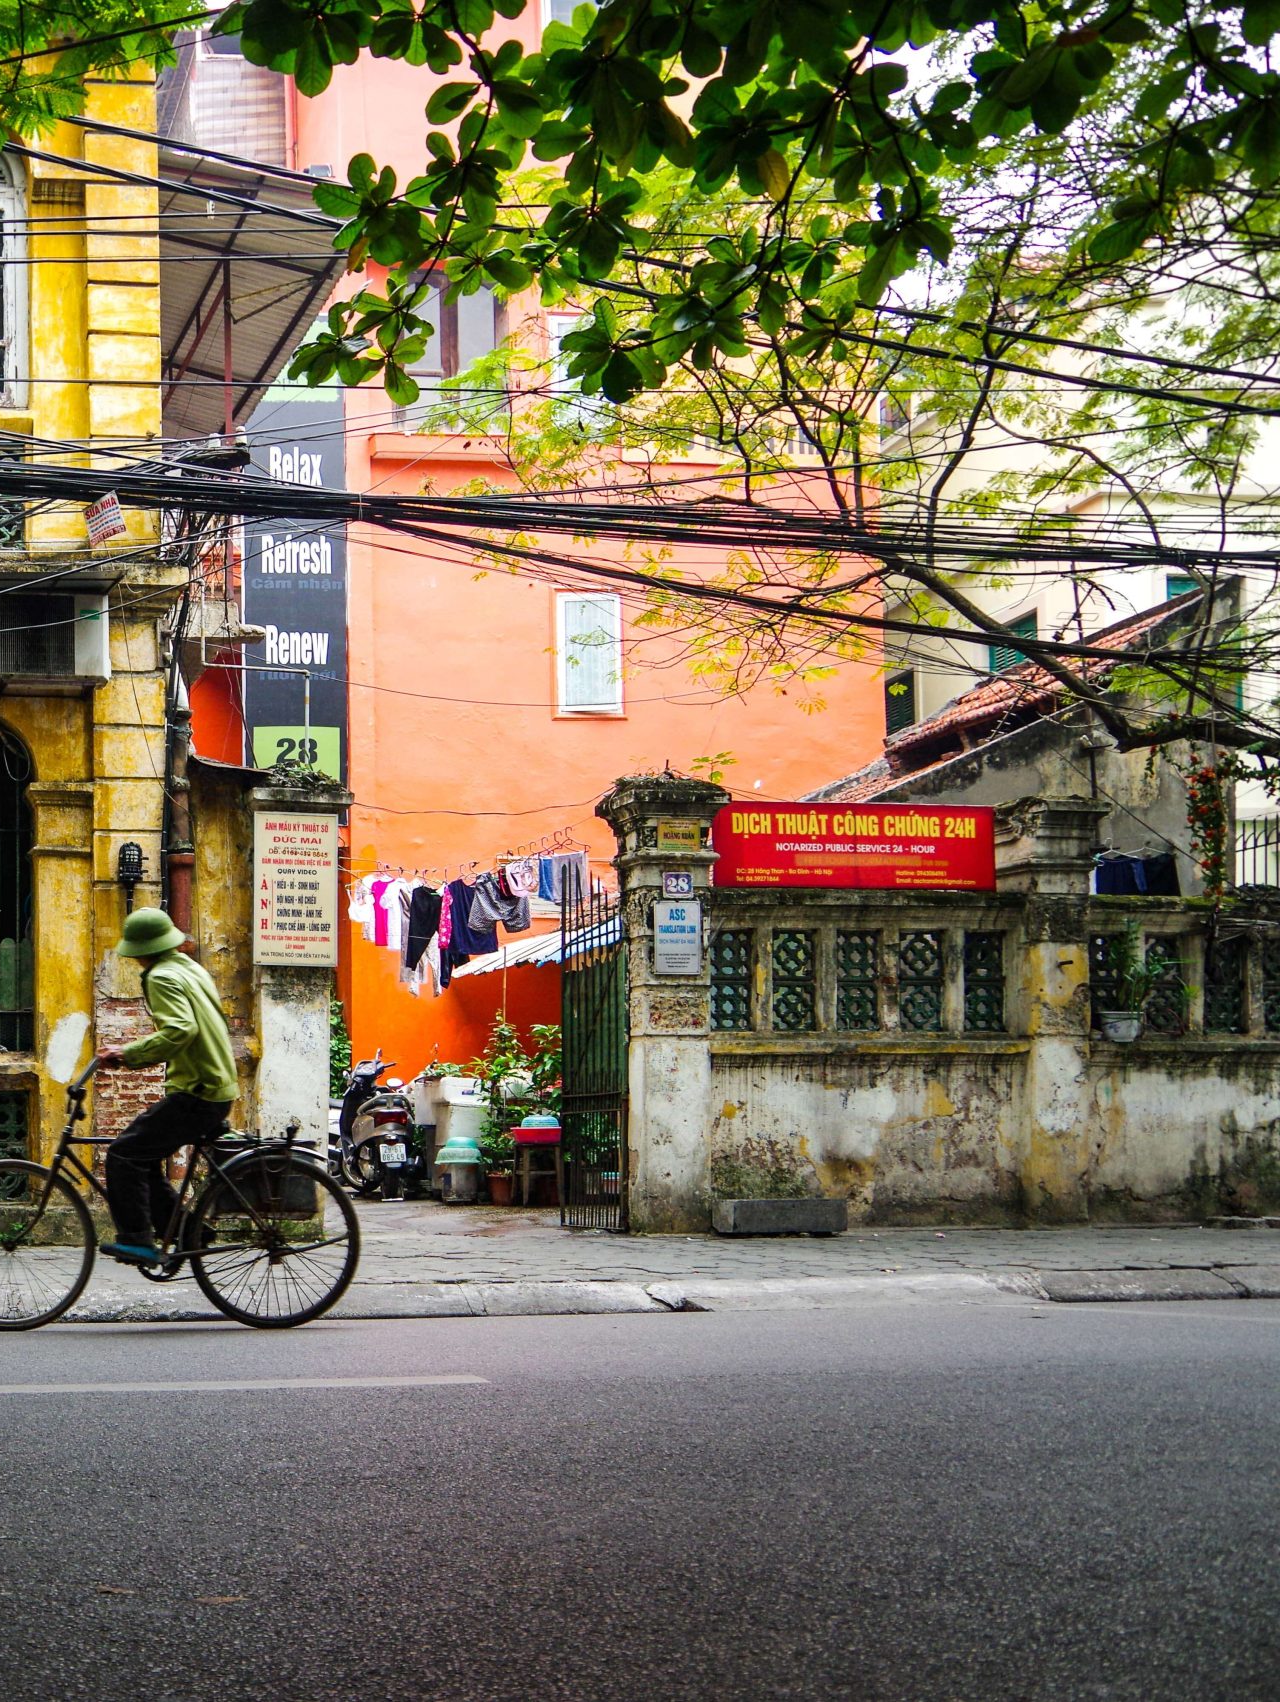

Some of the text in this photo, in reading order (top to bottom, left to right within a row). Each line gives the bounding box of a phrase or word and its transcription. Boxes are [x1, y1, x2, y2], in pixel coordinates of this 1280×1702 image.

[269, 446, 323, 487] Relax
[261, 534, 332, 575] Refresh
[265, 624, 329, 665] Renew
[276, 737, 318, 764] 28
[731, 810, 976, 840] DỊCH THUẬT CÔNG CHỨNG 24H
[273, 835, 322, 845] ĐỨC MAI
[775, 842, 824, 852] NOTARIZED
[825, 843, 855, 853] PUBLIC
[856, 844, 891, 853] SERVICE
[892, 844, 903, 853] 24
[910, 845, 936, 854] HOUR
[666, 877, 689, 893] 28
[669, 908, 686, 921] ASC
